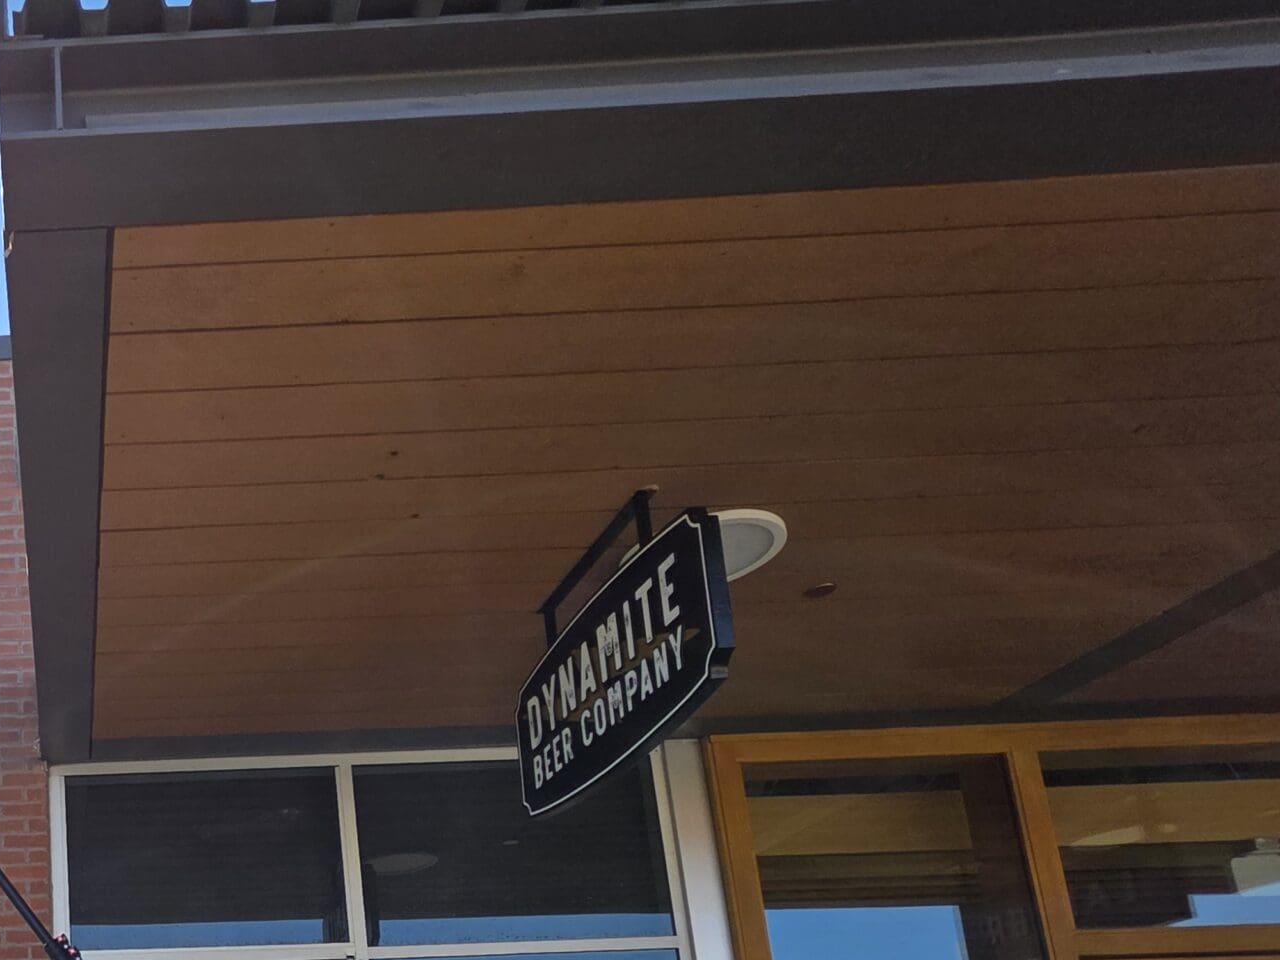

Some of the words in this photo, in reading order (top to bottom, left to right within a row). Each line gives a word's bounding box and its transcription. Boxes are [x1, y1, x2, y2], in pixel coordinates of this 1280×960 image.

[526, 552, 680, 750] DYNAMITE
[533, 727, 573, 790] BEER
[580, 626, 682, 746] COMPANY
